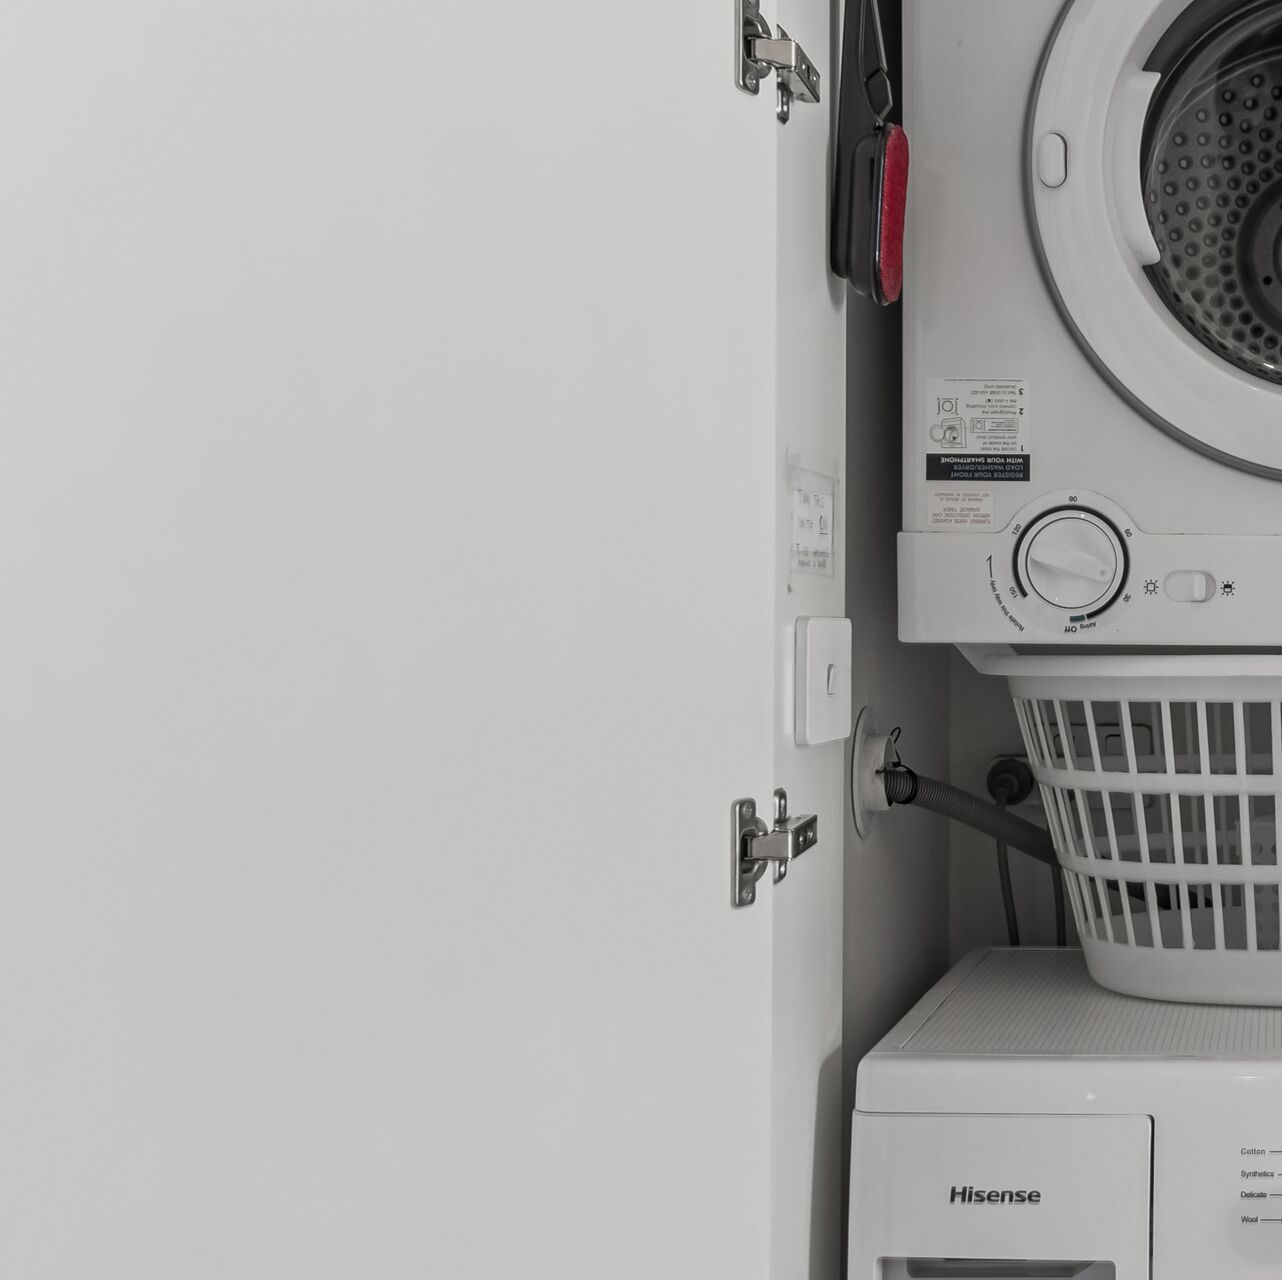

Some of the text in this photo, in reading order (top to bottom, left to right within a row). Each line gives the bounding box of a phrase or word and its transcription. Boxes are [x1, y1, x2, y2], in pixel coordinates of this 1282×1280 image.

[1020, 444, 1024, 452] 1
[1012, 523, 1022, 535] 120
[1124, 528, 1133, 537] 60
[990, 580, 998, 593] only
[1009, 586, 1019, 598] 150
[1123, 593, 1131, 603] 30
[1001, 604, 1009, 616] this
[1008, 614, 1025, 631] Rotate
[1064, 625, 1077, 633] Off
[1241, 1170, 1274, 1178] Synthetics
[949, 1186, 1041, 1204] Hisense
